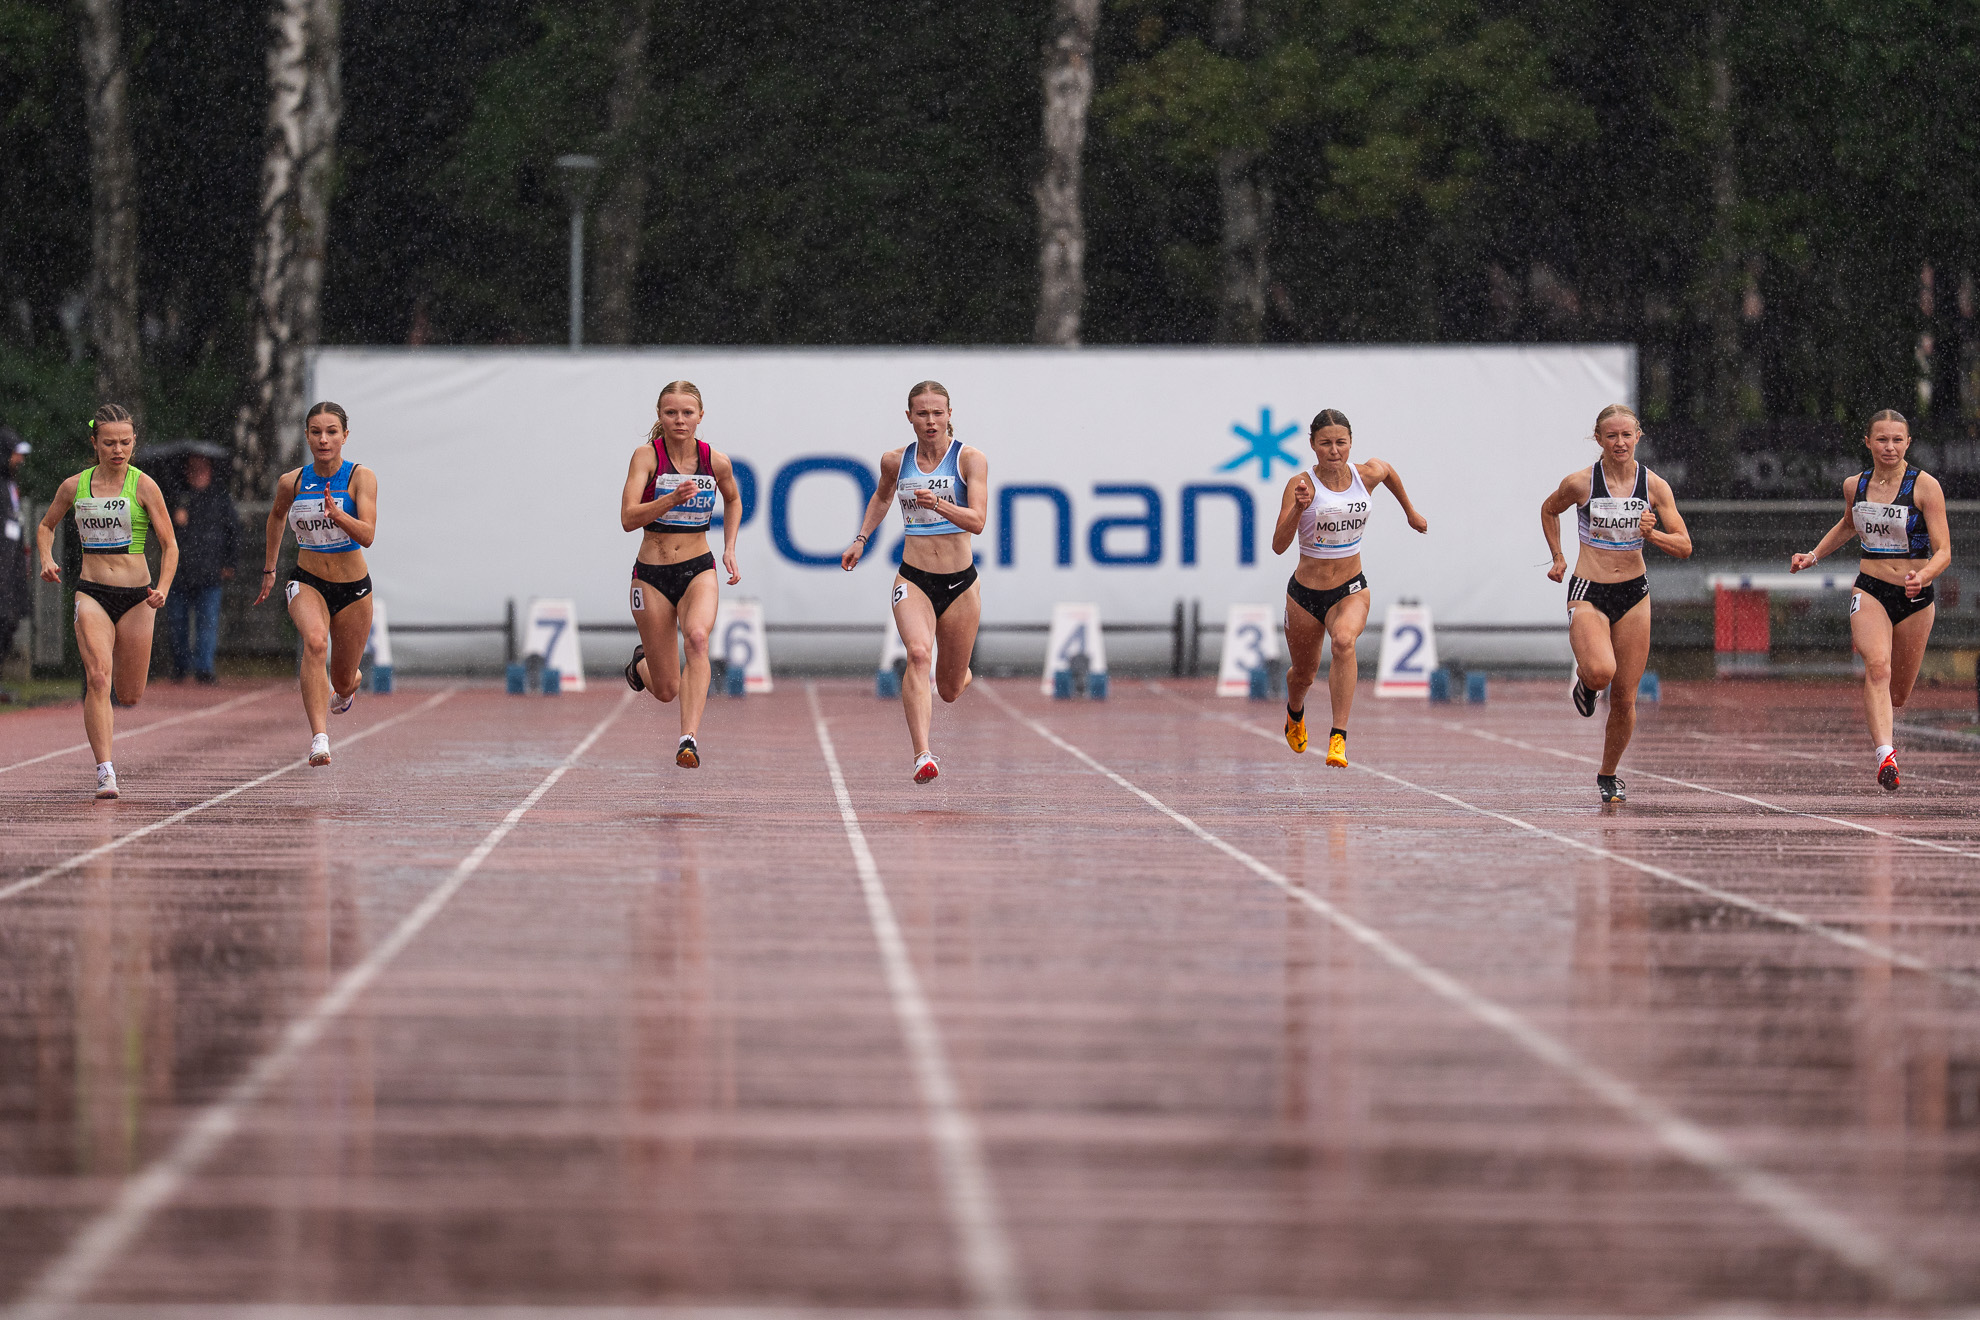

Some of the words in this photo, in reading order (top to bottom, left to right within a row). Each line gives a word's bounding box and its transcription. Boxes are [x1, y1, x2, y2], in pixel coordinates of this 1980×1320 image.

[928, 479, 948, 490] 241
[104, 500, 126, 511] 499
[1347, 501, 1367, 514] 739
[1623, 500, 1645, 511] 195
[1883, 507, 1902, 519] 701
[81, 517, 122, 529] KRUPA
[1592, 516, 1641, 529] SZLACHT
[1865, 522, 1890, 537] BĄK
[633, 589, 641, 609] 6
[894, 585, 903, 602] 5
[534, 618, 568, 668] 7
[724, 620, 754, 667] 6
[1235, 623, 1265, 671] 3
[1393, 624, 1426, 673] 2
